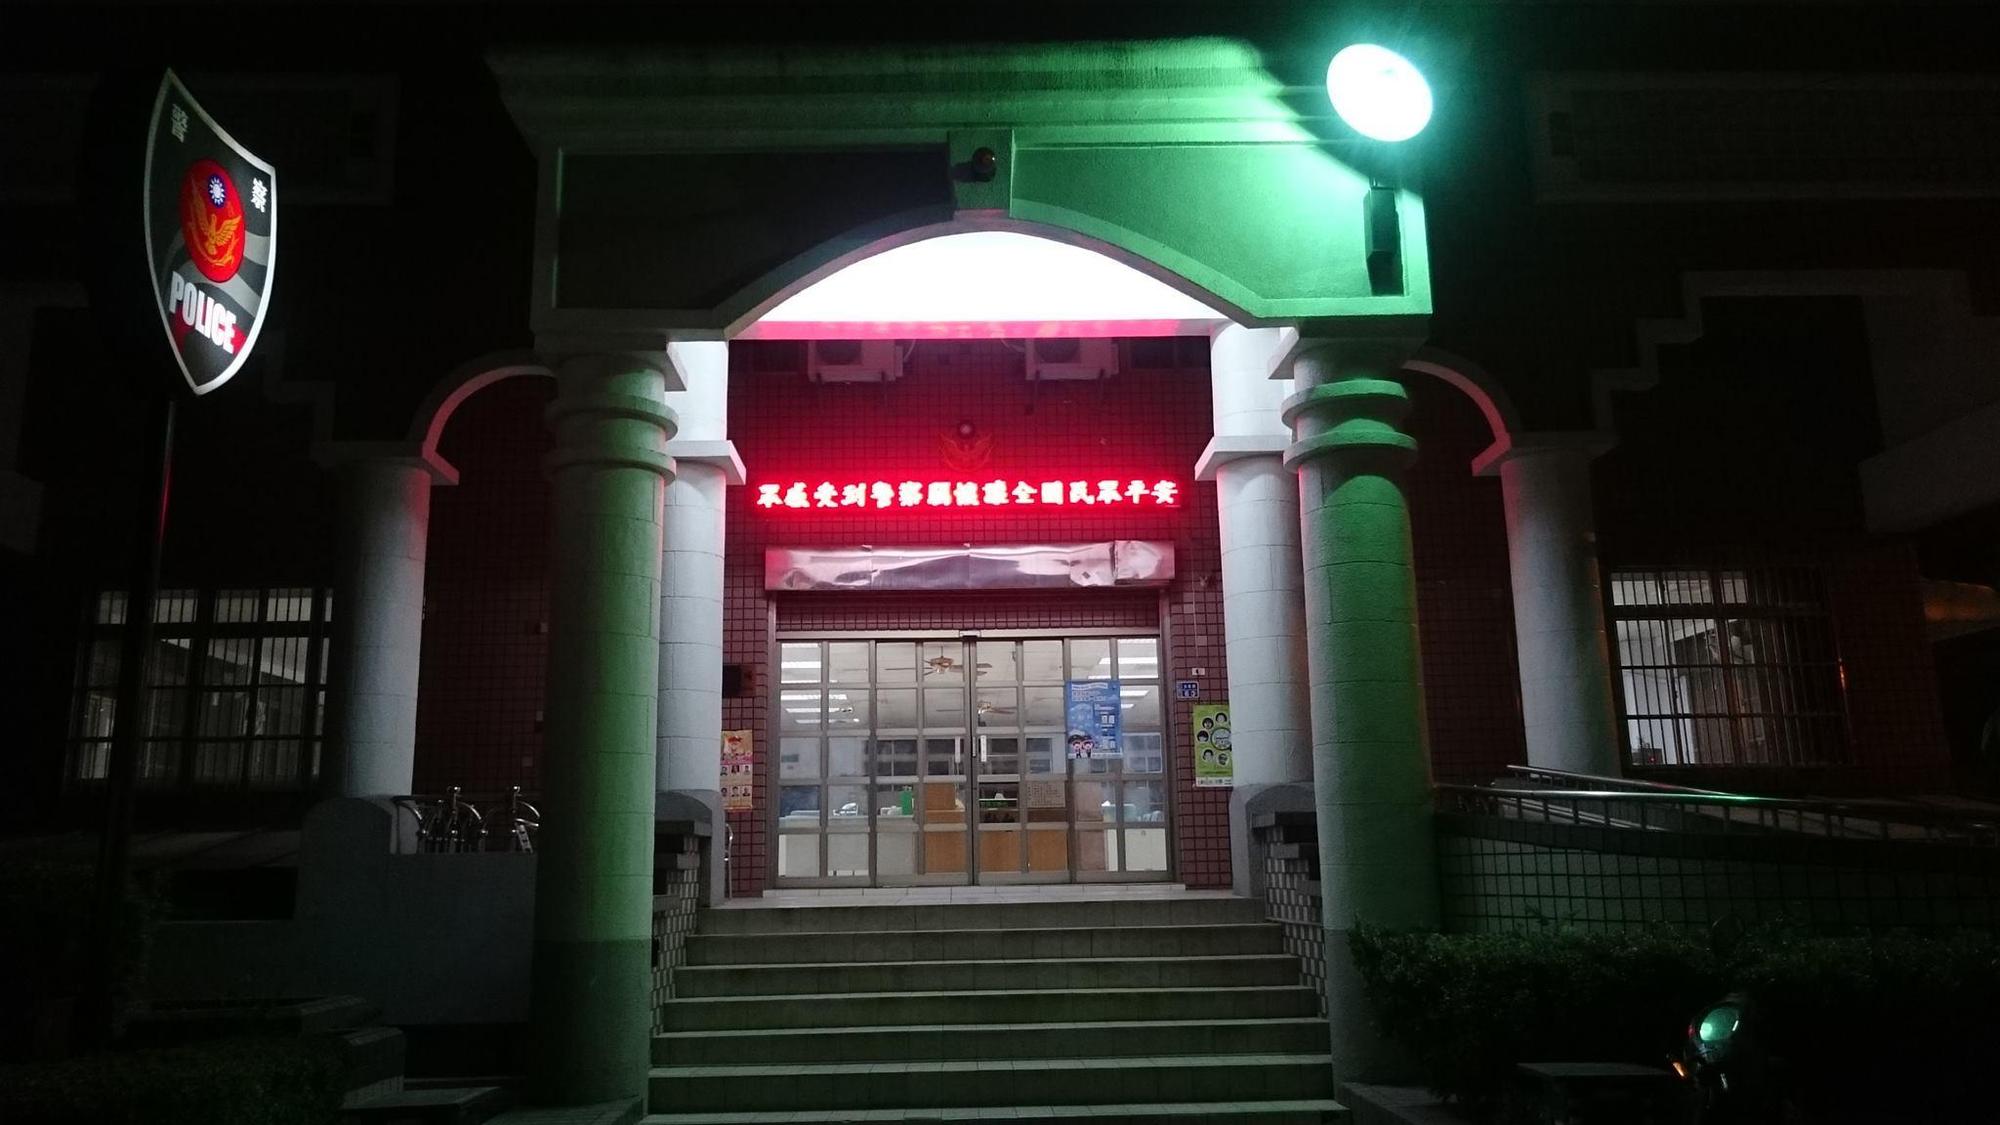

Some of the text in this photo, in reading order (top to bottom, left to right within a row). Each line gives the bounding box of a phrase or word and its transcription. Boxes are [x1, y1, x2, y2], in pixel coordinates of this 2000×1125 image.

[171, 103, 189, 143] 警
[251, 177, 268, 213] 察
[169, 270, 237, 355] POLICE
